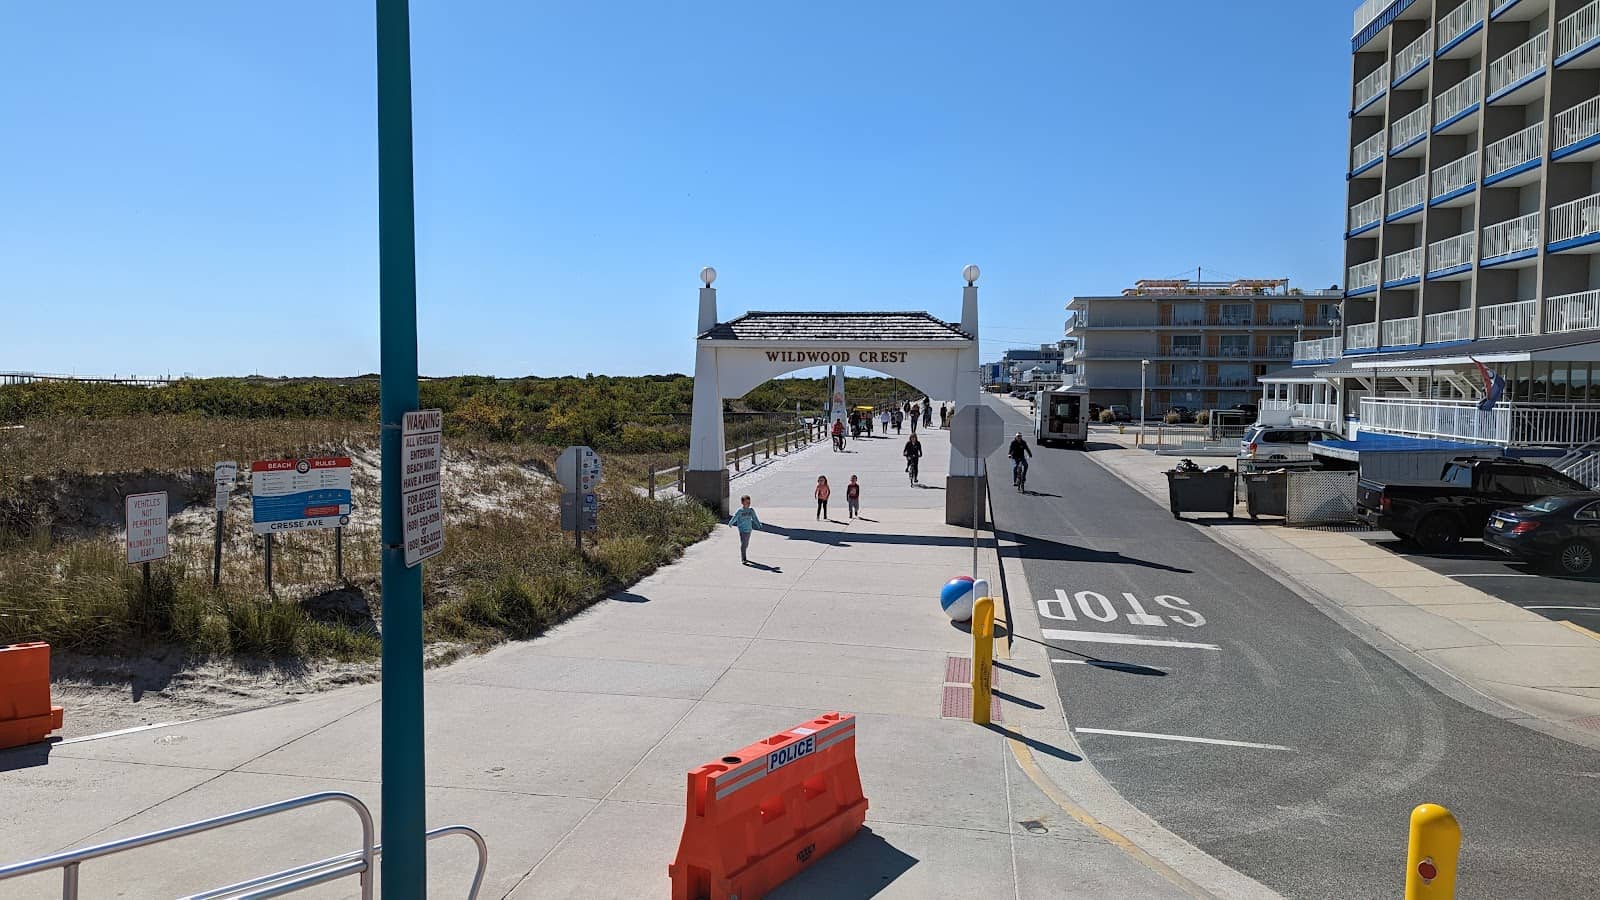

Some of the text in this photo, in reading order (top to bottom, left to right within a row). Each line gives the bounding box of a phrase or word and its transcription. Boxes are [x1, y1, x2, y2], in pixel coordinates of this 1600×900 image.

[766, 351, 908, 363] WILDWOOD CREST
[406, 412, 440, 430] WARNING
[406, 434, 439, 448] ALL VEHICLES
[410, 447, 435, 460] ENTERING
[406, 459, 437, 474] BEACH MUST
[403, 476, 417, 488] HAVE
[422, 471, 440, 485] PERMIT
[134, 498, 161, 509] VEHICLES
[407, 488, 437, 506] FOR ACCESS
[141, 508, 152, 517] NOT
[407, 498, 438, 516] PLEASE CALL
[133, 517, 163, 528] PERMITTED
[270, 520, 305, 530] CRESSE
[1037, 588, 1207, 628] STOP
[769, 738, 813, 770] POLICE
